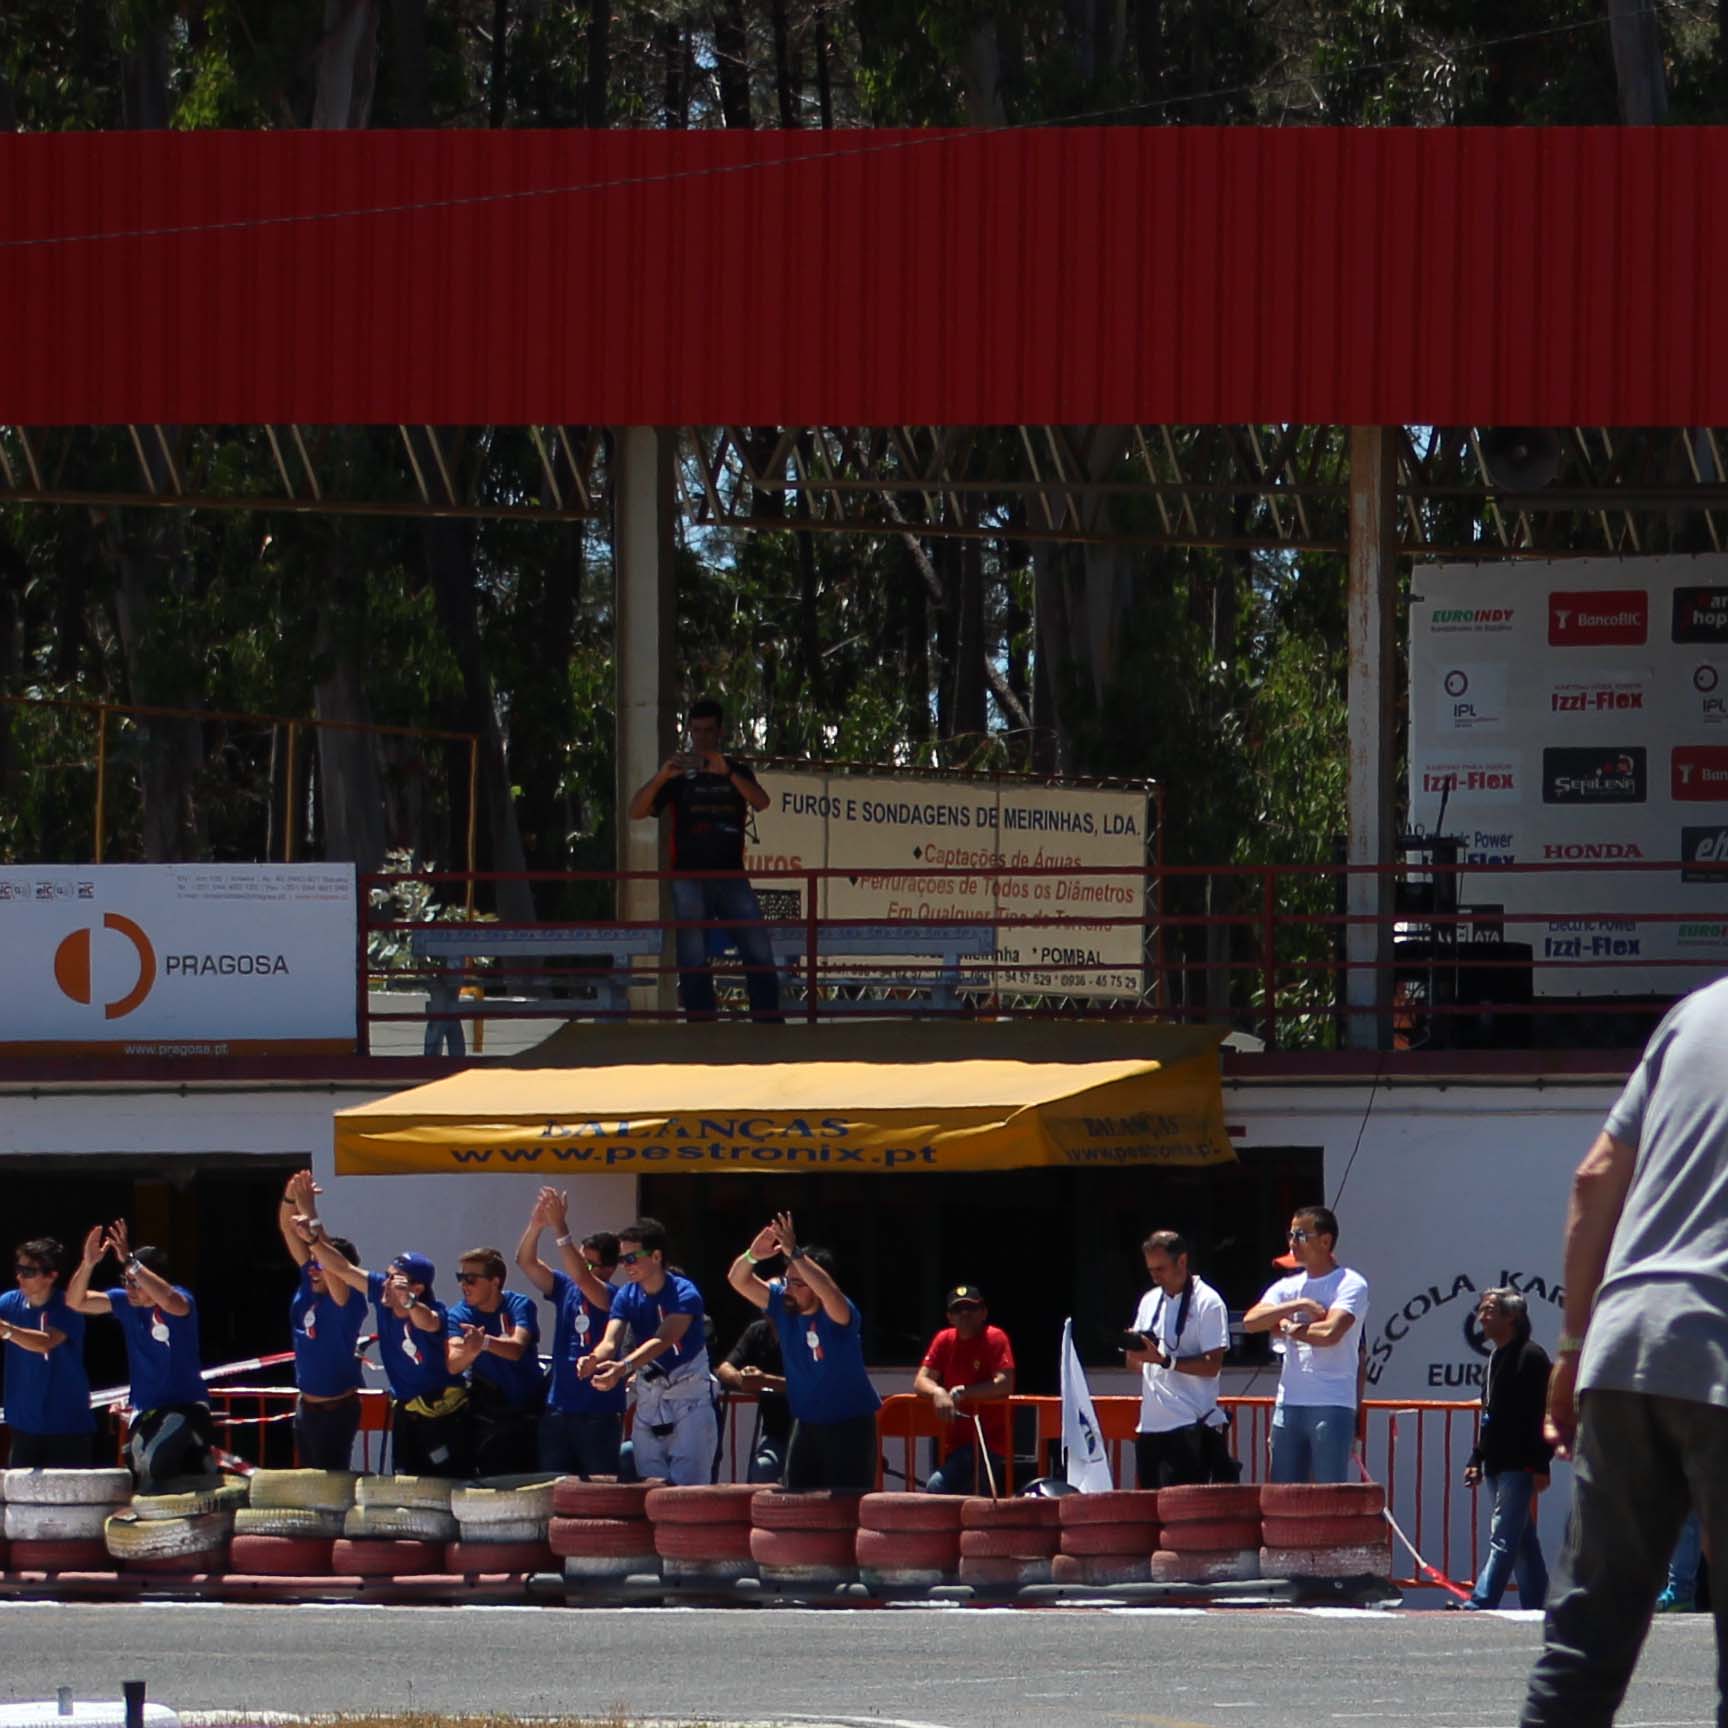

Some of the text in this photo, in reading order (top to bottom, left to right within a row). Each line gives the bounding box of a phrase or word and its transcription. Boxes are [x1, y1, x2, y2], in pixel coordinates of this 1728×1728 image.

[1431, 608, 1515, 623] EUROINDY
[1577, 611, 1642, 627] BancoBIC
[1551, 691, 1644, 712] Izzi-Flex
[1422, 771, 1515, 793] Izzi-Flex
[781, 792, 1141, 838] FUROS E SONDAGENS DE MEIRINHAS, LDA.
[1474, 831, 1514, 849] Power
[1543, 843, 1644, 859] HONDA
[924, 843, 1082, 868] Captações de Águas
[959, 877, 978, 896] de
[983, 876, 1030, 898] Todos
[1034, 883, 1051, 900] os
[1055, 880, 1135, 904] Diâmetros
[1041, 947, 1104, 966] POMBAL
[1544, 936, 1641, 958] Izzi-Flex
[166, 954, 290, 976] PRAGOSA
[451, 1142, 938, 1167] www.pestronix.pt
[1365, 1273, 1476, 1386] ESCOLA
